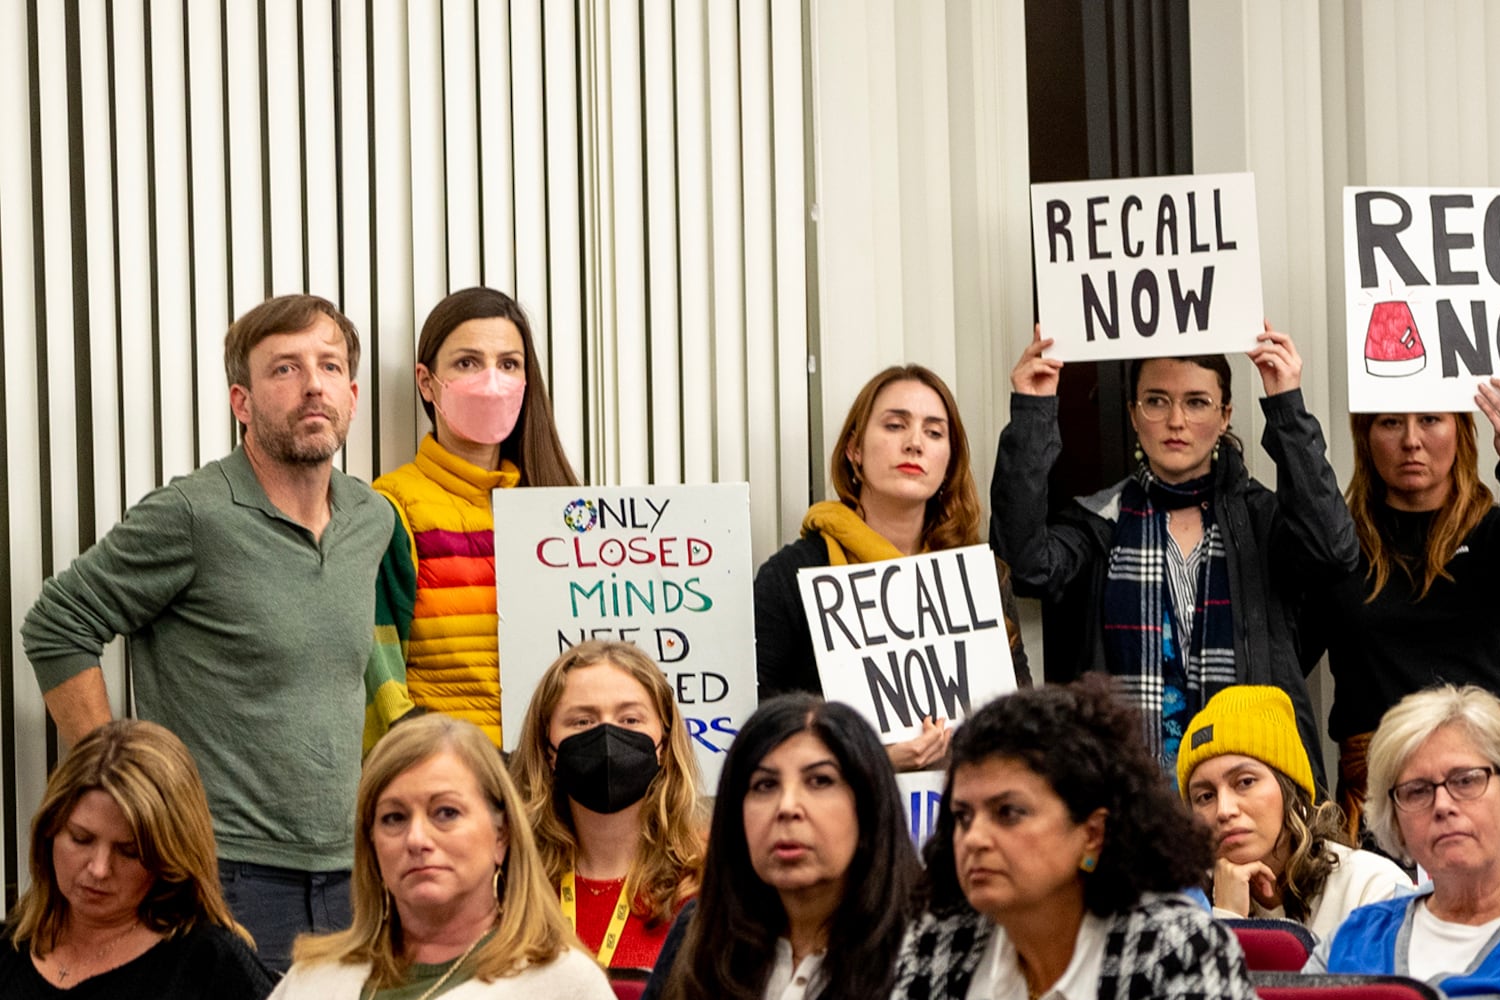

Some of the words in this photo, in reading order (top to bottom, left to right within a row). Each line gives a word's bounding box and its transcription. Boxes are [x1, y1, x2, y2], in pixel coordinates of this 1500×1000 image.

[1046, 188, 1237, 263] RECALL
[1081, 265, 1215, 342] NOW
[536, 537, 713, 568] CLOSED
[563, 497, 671, 533] ONLY
[812, 553, 998, 652] RECALL
[862, 640, 971, 733] NOW
